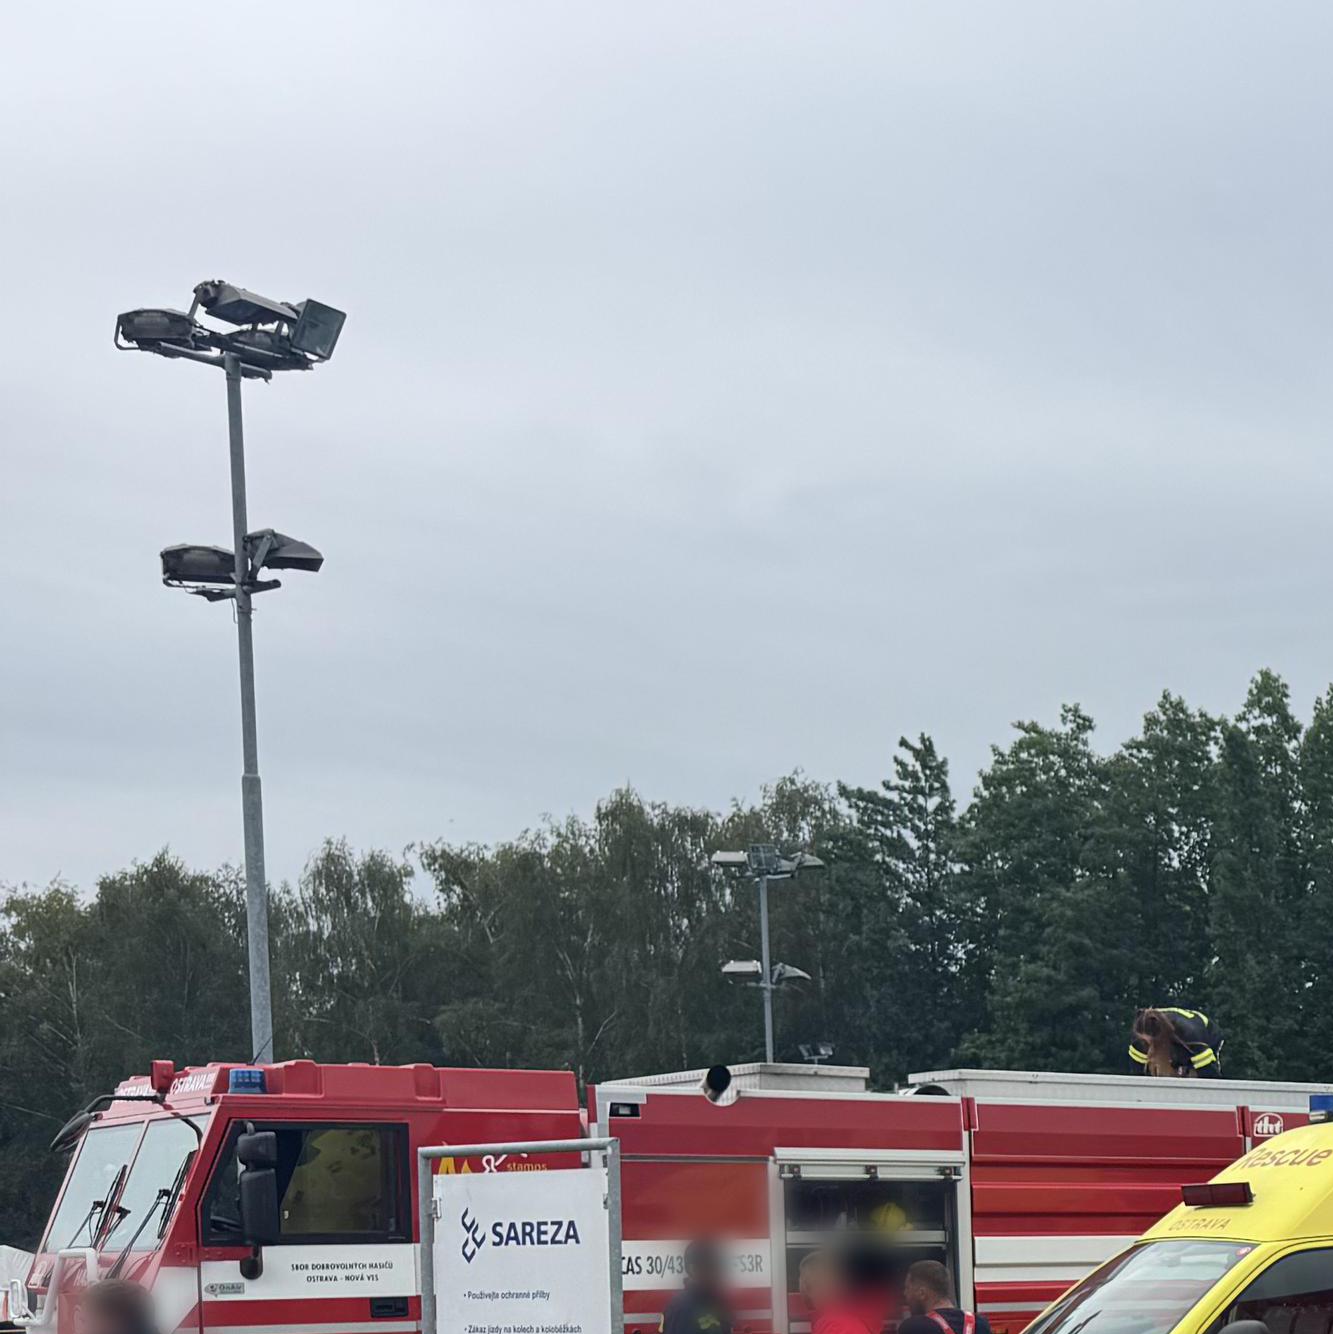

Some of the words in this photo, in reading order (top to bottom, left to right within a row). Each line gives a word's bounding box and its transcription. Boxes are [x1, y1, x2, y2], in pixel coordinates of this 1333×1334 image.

[1236, 1147, 1333, 1170] Rescue
[491, 1219, 581, 1247] SAREZA
[1168, 1216, 1231, 1231] OSTRAVA
[646, 1254, 684, 1279] 30/43
